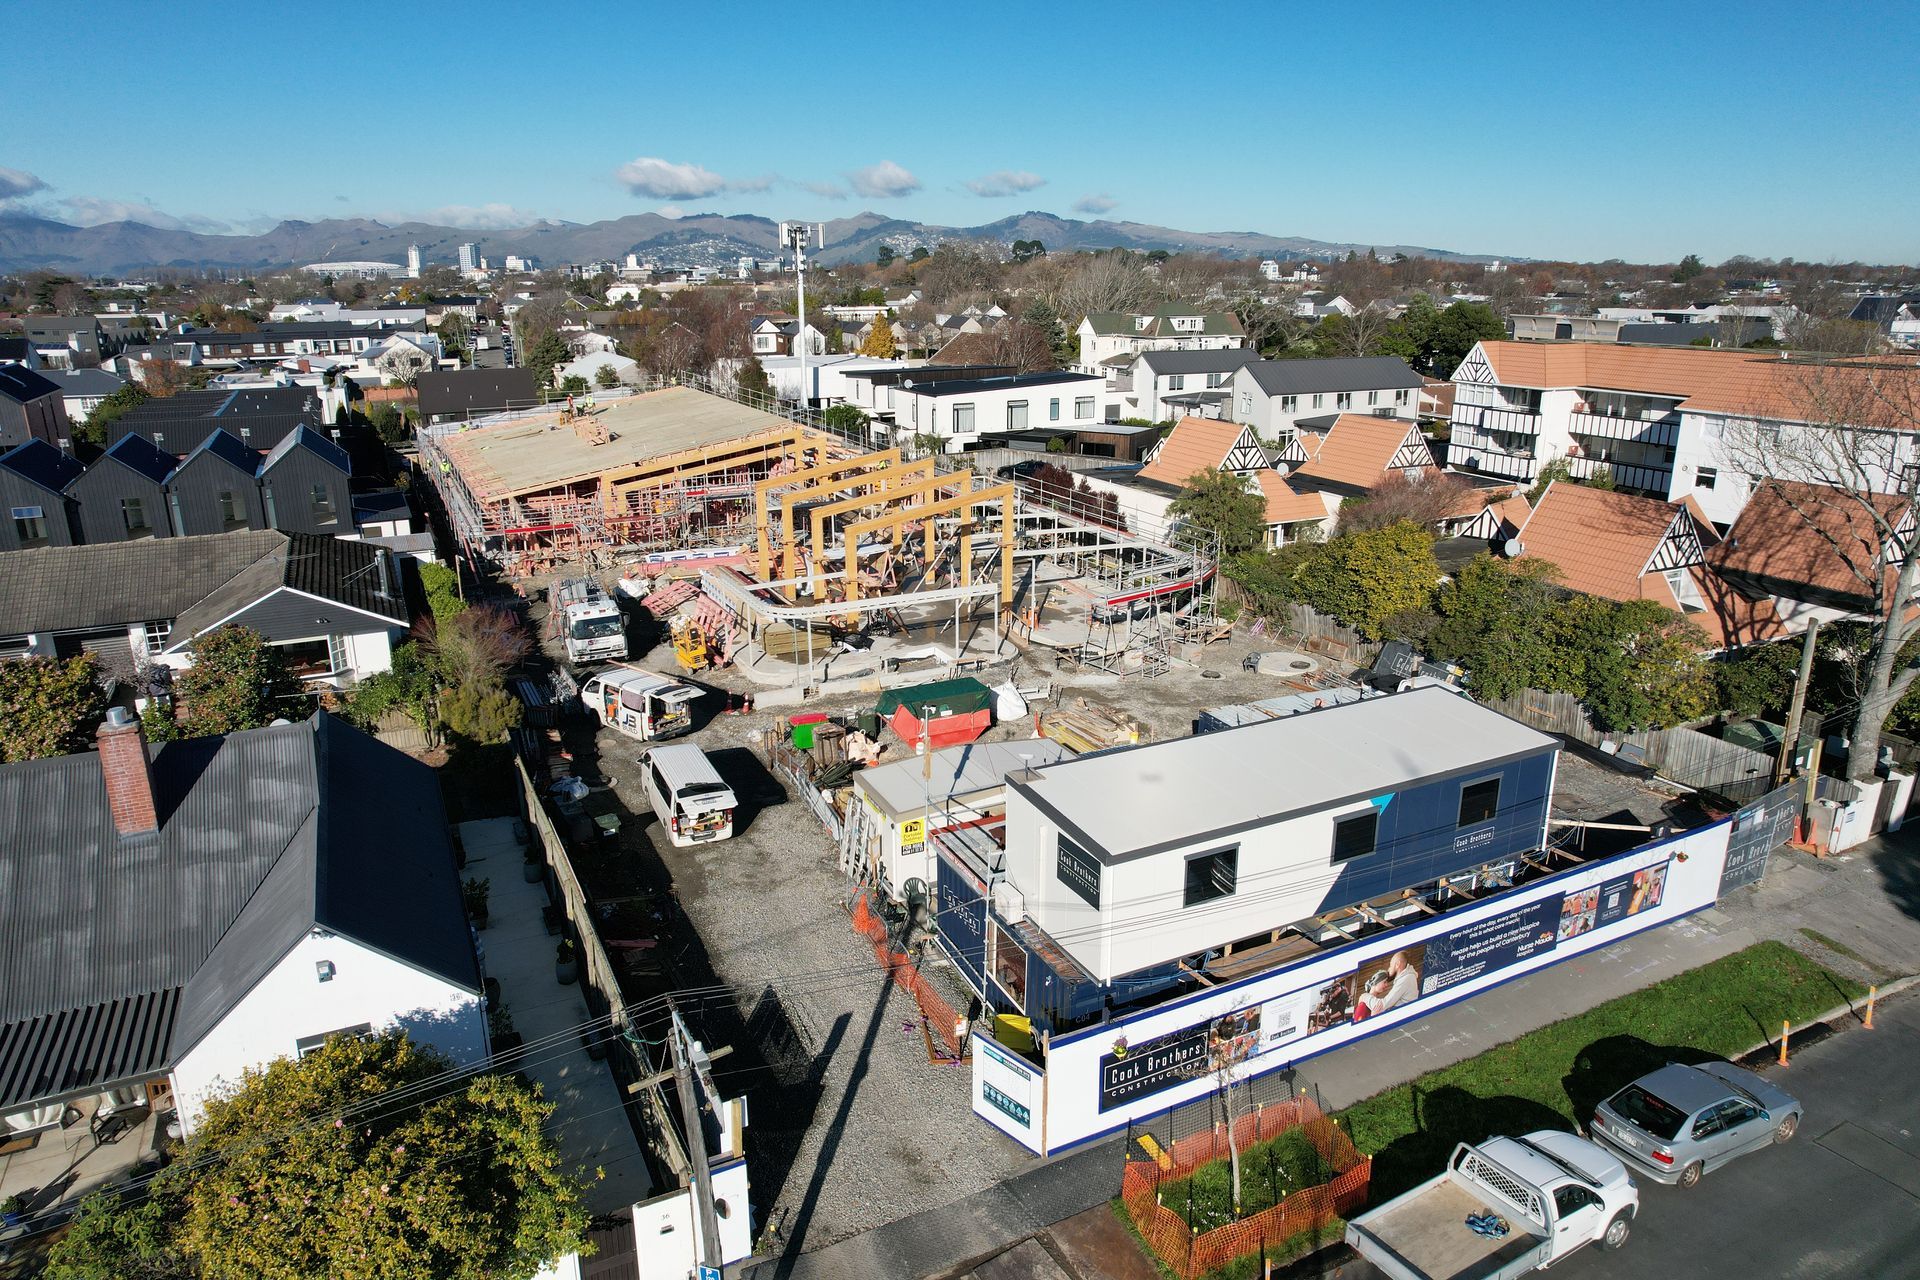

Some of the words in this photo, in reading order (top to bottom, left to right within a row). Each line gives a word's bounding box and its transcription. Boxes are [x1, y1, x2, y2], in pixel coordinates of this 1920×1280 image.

[1060, 850, 1072, 867] Cook
[1074, 860, 1097, 886] Brothers
[1450, 947, 1469, 958] Please
[1469, 942, 1482, 952] help
[1490, 933, 1503, 944] build
[1519, 921, 1540, 933] Hospice
[1467, 950, 1476, 959] the
[1476, 944, 1495, 957] people
[1501, 931, 1531, 946] Canterbury
[1516, 948, 1534, 958] Hospice
[1517, 943, 1535, 952] Nurse
[1535, 935, 1554, 947] Maude
[1112, 1062, 1139, 1084] Cook
[1148, 1045, 1200, 1072] Brothers
